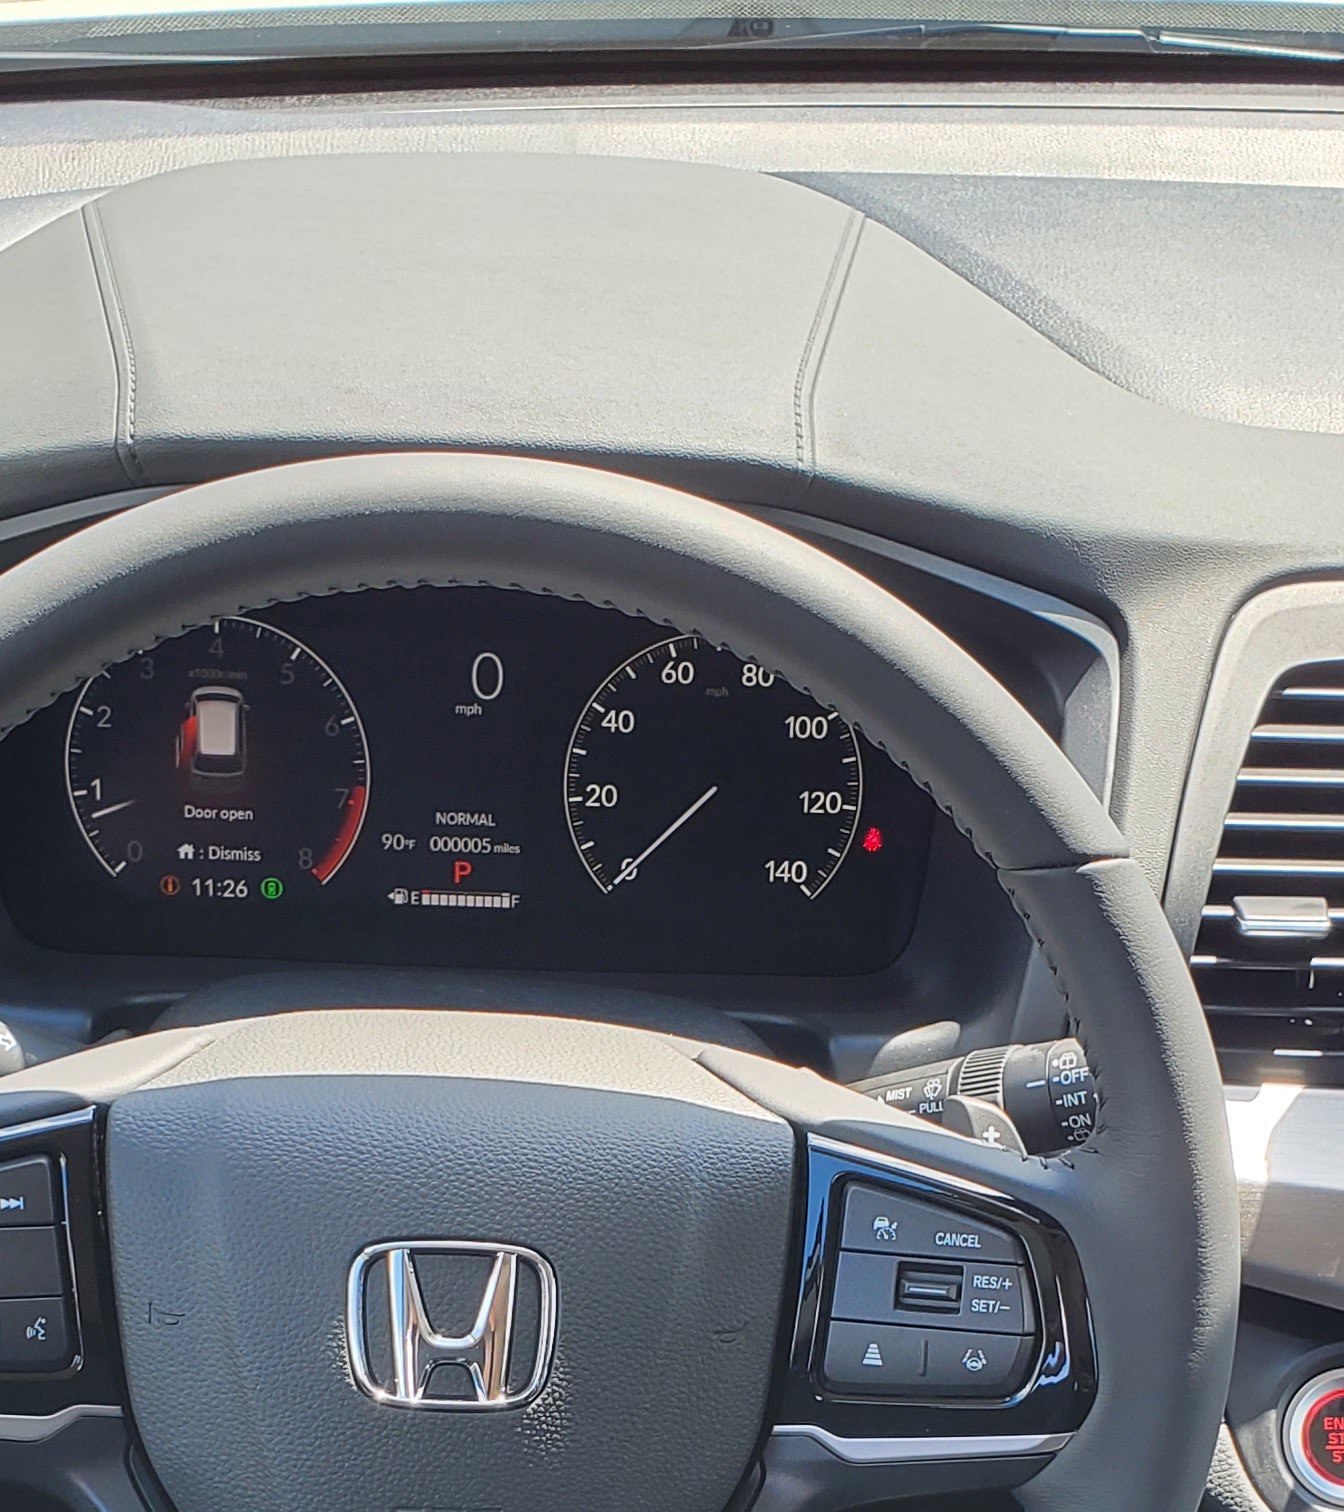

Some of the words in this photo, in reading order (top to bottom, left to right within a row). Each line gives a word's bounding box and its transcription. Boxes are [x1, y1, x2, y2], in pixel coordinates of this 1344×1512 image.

[208, 637, 225, 659] 4
[139, 658, 155, 680] 3
[280, 664, 295, 685] 5
[472, 652, 504, 700] 0
[661, 662, 695, 684] 60
[741, 664, 775, 687] 80
[97, 706, 112, 728] 2
[455, 703, 482, 716] mph
[325, 716, 340, 737] 6
[601, 710, 635, 733] 40
[784, 716, 828, 739] 100
[90, 779, 102, 800] 1
[334, 789, 348, 810] 7
[585, 784, 618, 807] 20
[800, 791, 842, 814] 120
[183, 805, 218, 820] Door
[220, 807, 254, 822] open
[435, 812, 496, 828] NORMAL
[127, 840, 143, 862] 0
[208, 846, 262, 862] Dismiss
[429, 836, 492, 853] 000005
[493, 843, 521, 854] miles
[298, 848, 313, 869] 8
[453, 861, 473, 884] P
[765, 861, 808, 883] 140
[191, 878, 249, 898] 11:26
[411, 891, 421, 904] E
[1060, 1067, 1089, 1085] OFF
[886, 1087, 913, 1101] MIST
[1063, 1091, 1087, 1108] INT
[1068, 1113, 1092, 1128] ON
[935, 1231, 982, 1249] CANCEL
